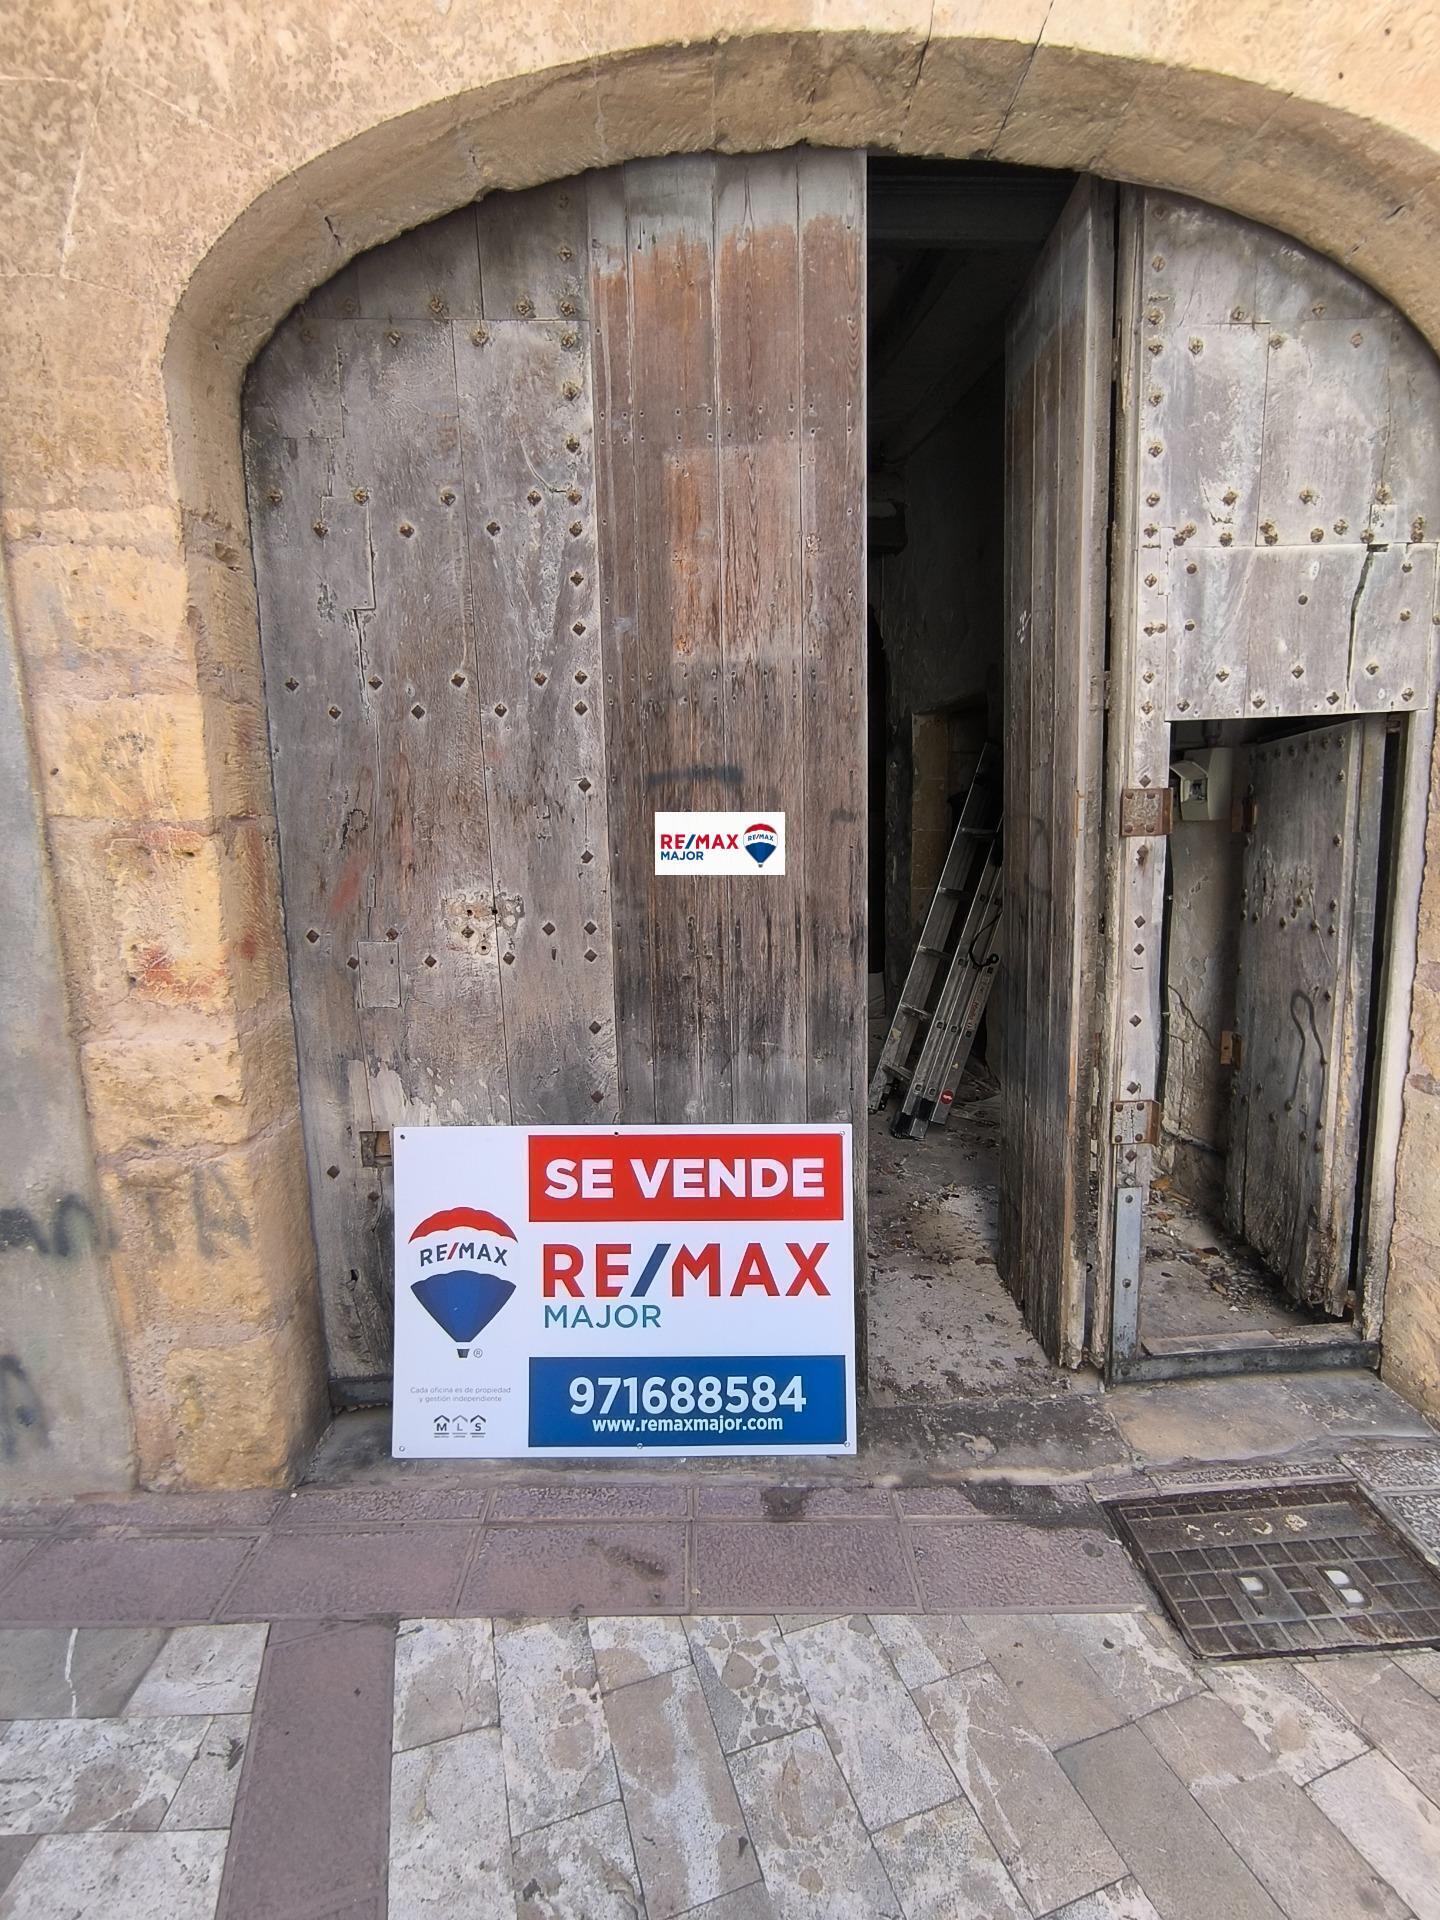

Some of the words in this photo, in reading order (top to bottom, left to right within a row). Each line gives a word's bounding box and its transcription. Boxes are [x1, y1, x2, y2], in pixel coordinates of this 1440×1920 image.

[544, 1158, 614, 1199] SE
[630, 1157, 825, 1198] VENDE
[420, 1242, 508, 1267] RE/MAX
[542, 1242, 832, 1298] RE/MAX
[543, 1304, 662, 1329] MAJOR
[410, 1386, 429, 1394] Cada
[429, 1386, 453, 1394] oficina
[464, 1386, 474, 1394] de
[475, 1386, 512, 1396] propiedad
[452, 1394, 502, 1403] independiente
[569, 1375, 807, 1415] 971688584
[591, 1415, 783, 1434] www.remaxmajor.com
